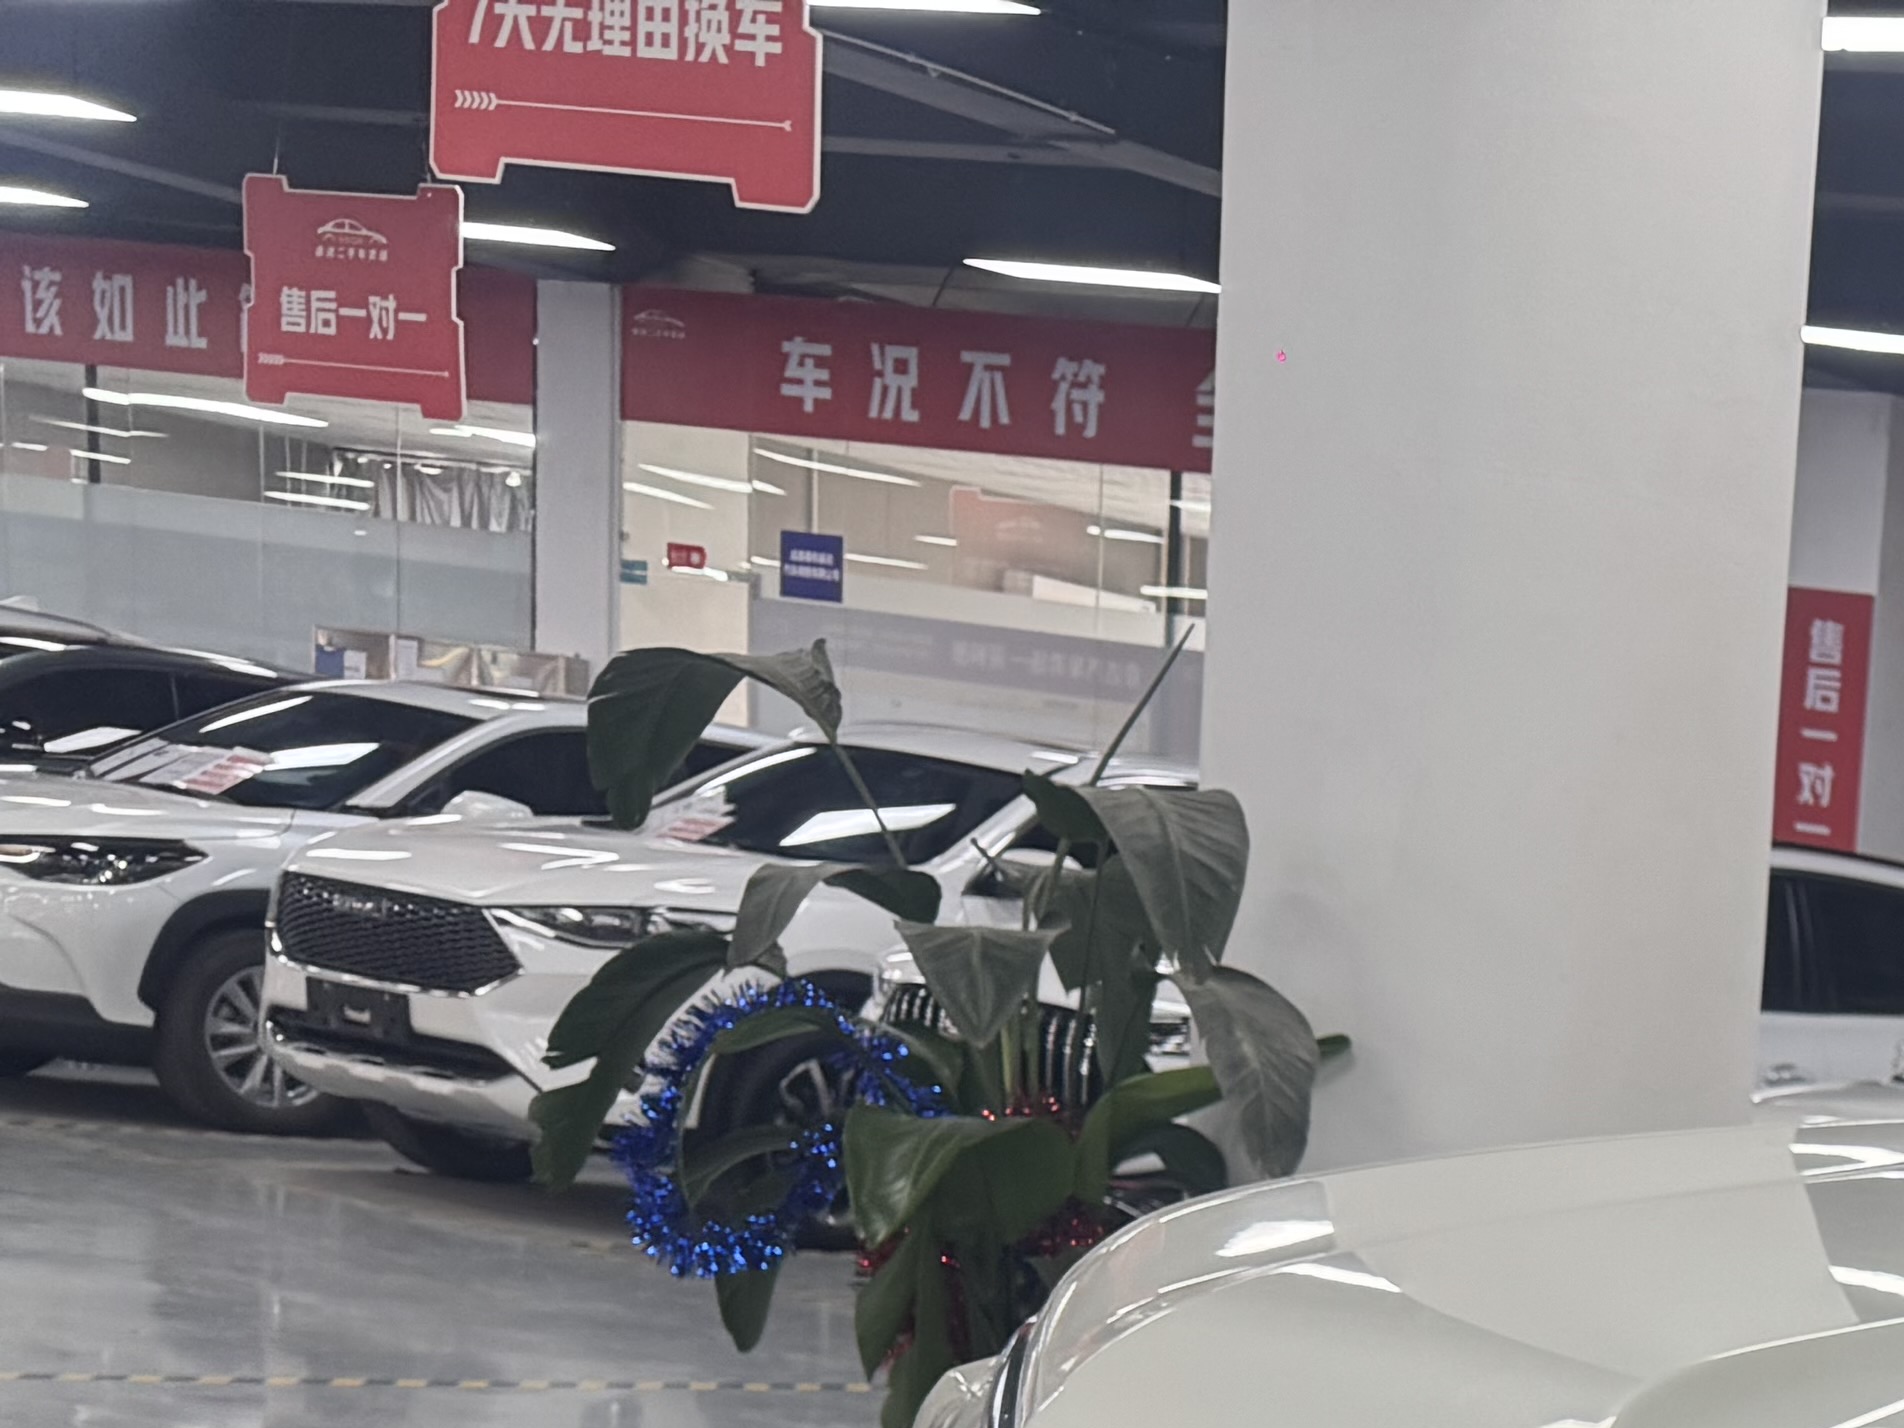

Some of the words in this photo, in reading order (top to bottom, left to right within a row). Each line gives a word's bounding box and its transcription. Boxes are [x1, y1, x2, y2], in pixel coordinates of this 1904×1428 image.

[21, 264, 252, 353] 该如此
[280, 286, 427, 340] 售后一对一
[780, 336, 1106, 439] 车况不符
[1793, 617, 1845, 836] 售后一对一
